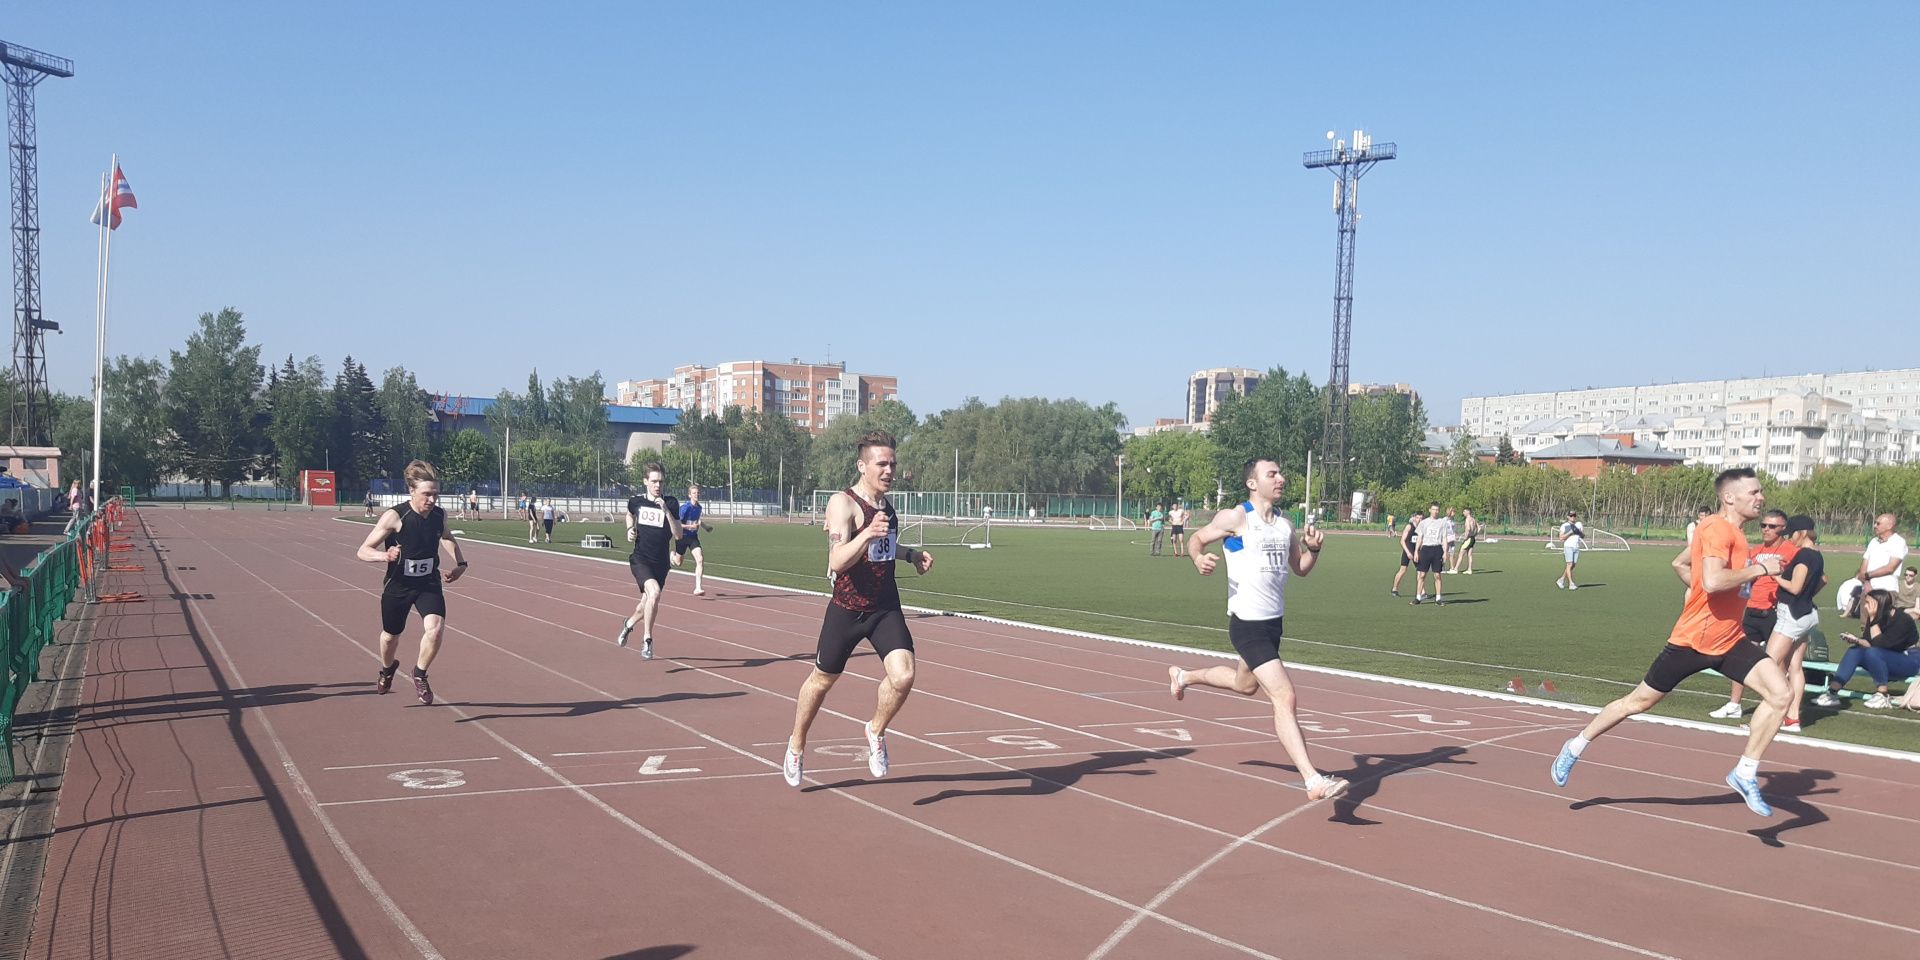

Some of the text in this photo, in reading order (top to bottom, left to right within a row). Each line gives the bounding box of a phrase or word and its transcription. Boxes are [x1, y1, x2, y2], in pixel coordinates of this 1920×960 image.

[641, 510, 661, 523] 031
[878, 538, 890, 554] 38
[1266, 551, 1283, 566] 111
[410, 563, 428, 573] 15
[387, 768, 466, 790] 8
